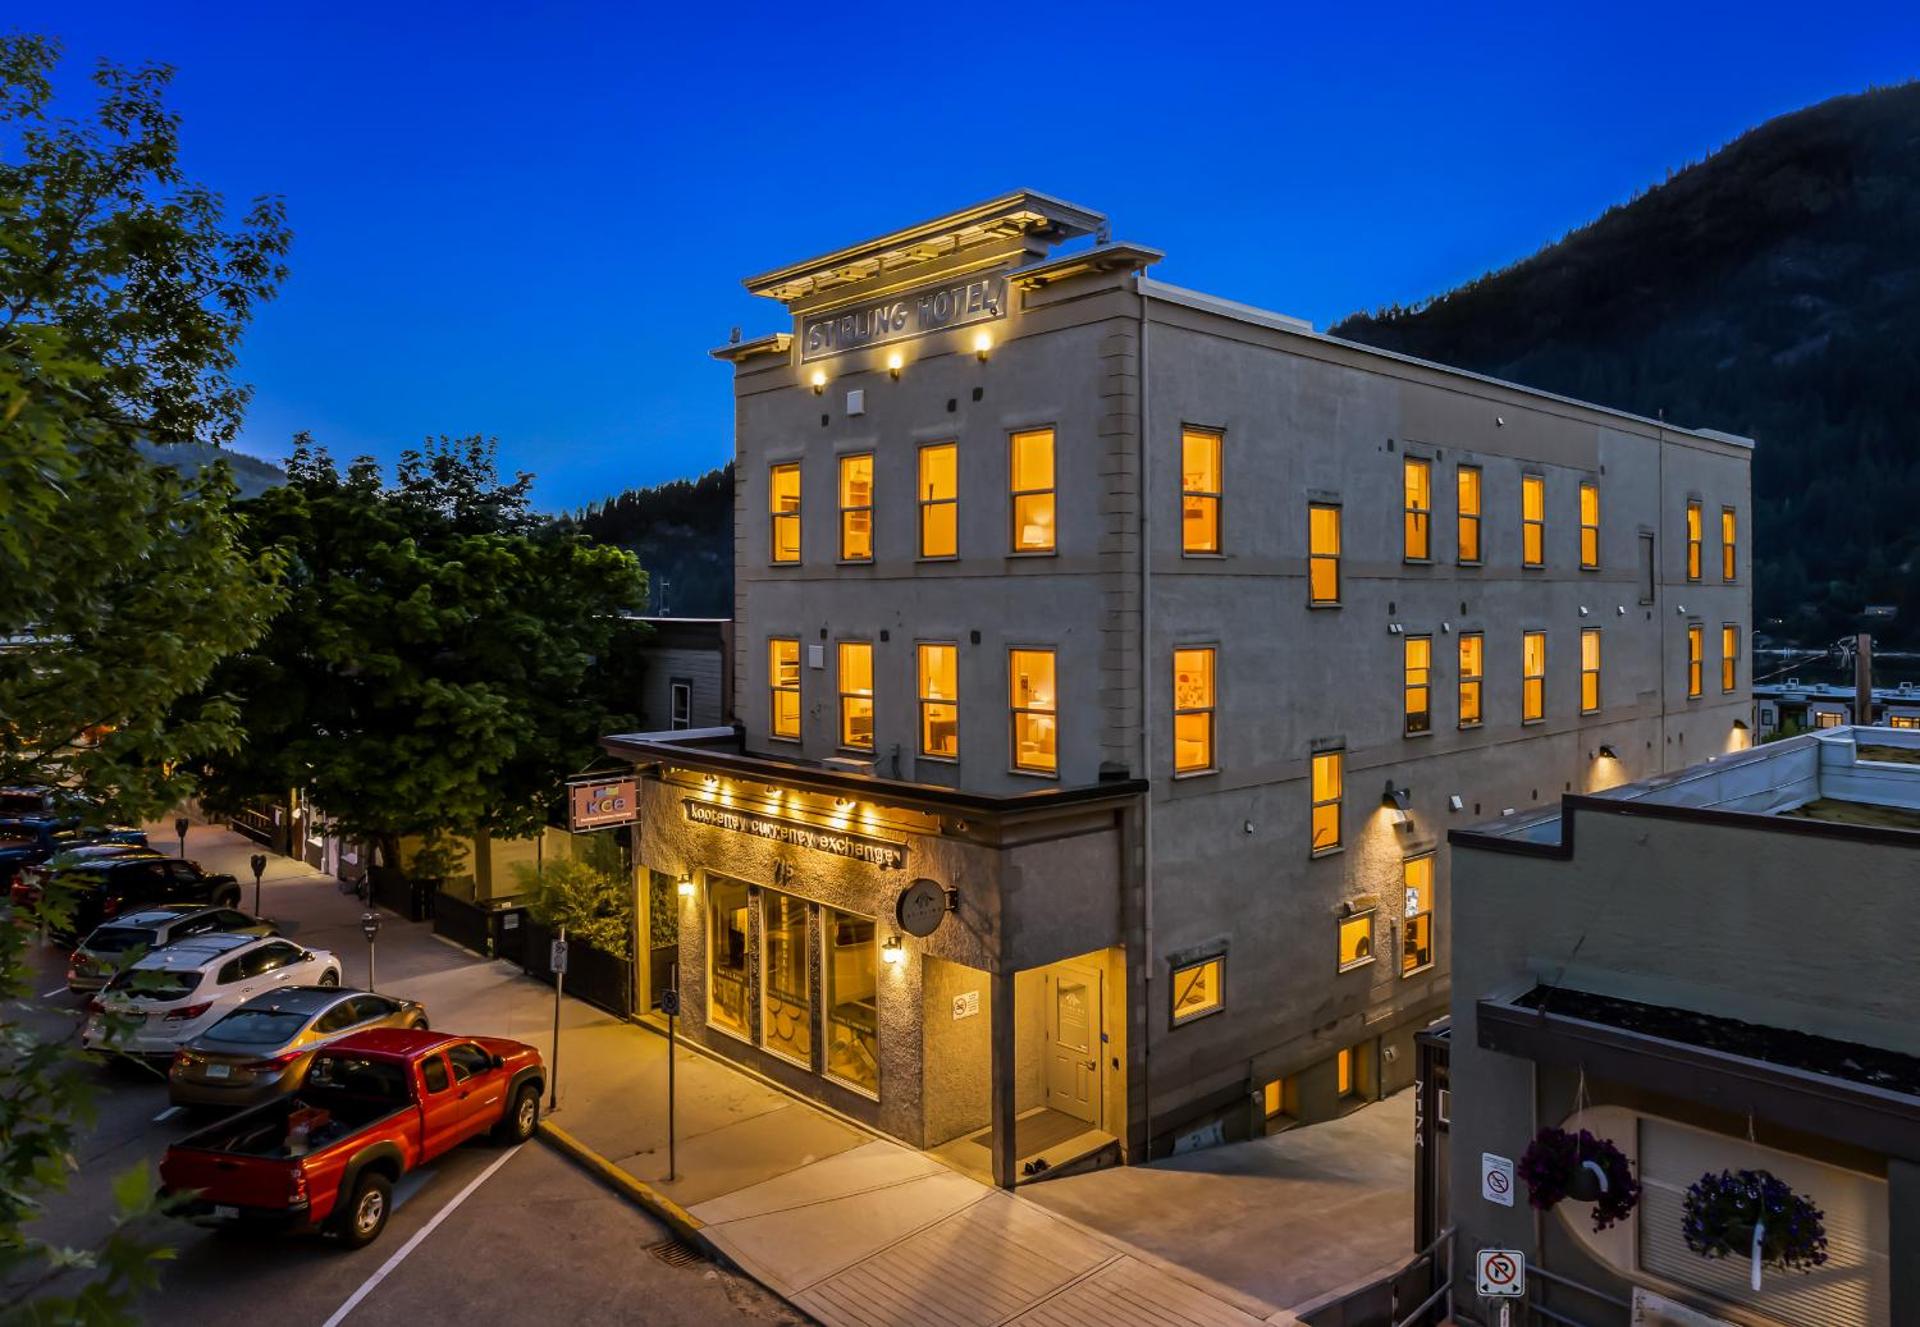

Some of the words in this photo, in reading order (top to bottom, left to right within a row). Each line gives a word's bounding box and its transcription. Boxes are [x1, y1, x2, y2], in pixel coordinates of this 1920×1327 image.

[808, 301, 909, 351] STIRLING
[917, 280, 998, 328] HOTEL
[691, 803, 746, 831] kootenay
[751, 820, 815, 848] currency
[820, 835, 894, 864] exchange
[1415, 1080, 1424, 1147] 717A
